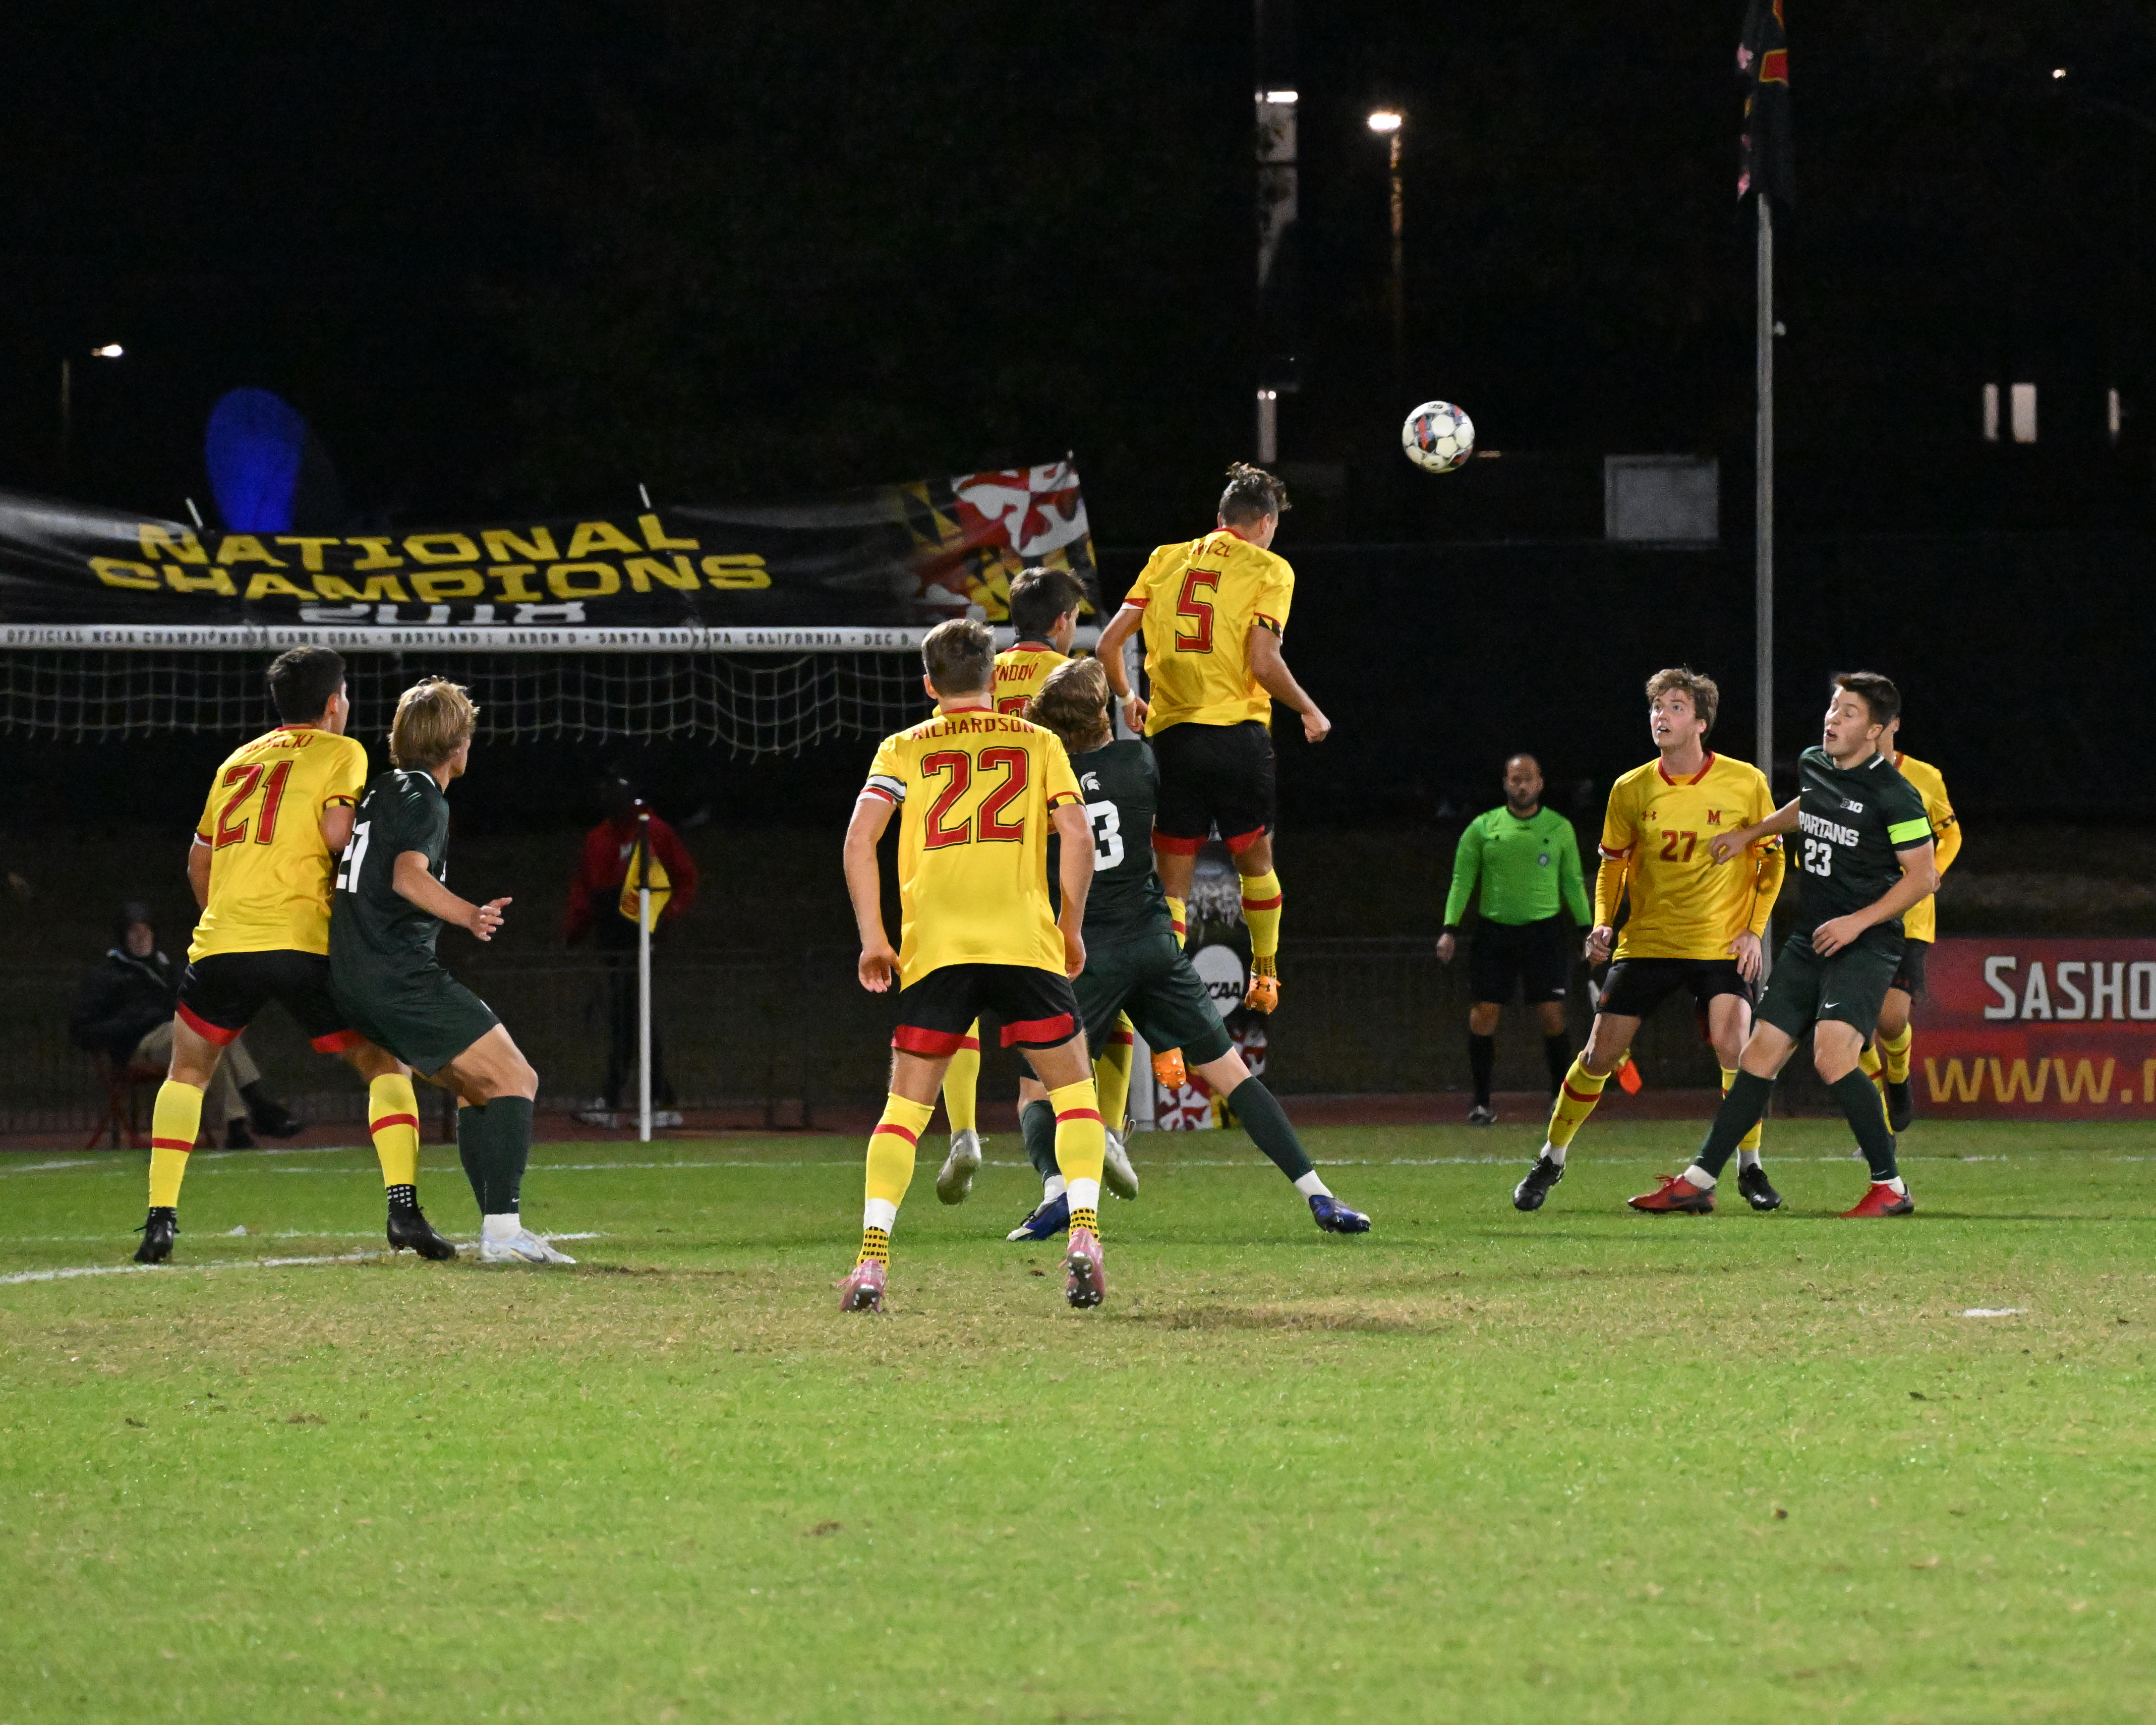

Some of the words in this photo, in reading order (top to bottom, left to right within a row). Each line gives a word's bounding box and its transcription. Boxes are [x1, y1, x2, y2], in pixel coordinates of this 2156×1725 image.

[139, 513, 700, 571] NATIONAL
[88, 553, 772, 603] CHAMPIONS
[1175, 568, 1221, 654] 5
[7, 631, 83, 645] OFFICIAL
[92, 631, 135, 645] NCAA
[276, 631, 319, 645] GAME
[328, 631, 369, 645] GOAL
[391, 631, 479, 645] MARYLAND
[508, 631, 560, 645] AKRON
[599, 631, 650, 645] SANTA
[746, 631, 842, 645] CALIFORNIA
[864, 631, 893, 645] DEC
[912, 717, 1035, 741] RICHARDSON
[215, 760, 294, 851] 21
[921, 746, 1029, 850] 22
[1707, 810, 1721, 826] M
[1660, 830, 1698, 862] 27
[1798, 811, 1859, 847] PARTANS
[1804, 838, 1832, 877] 23
[1984, 955, 2156, 1021] SASHO
